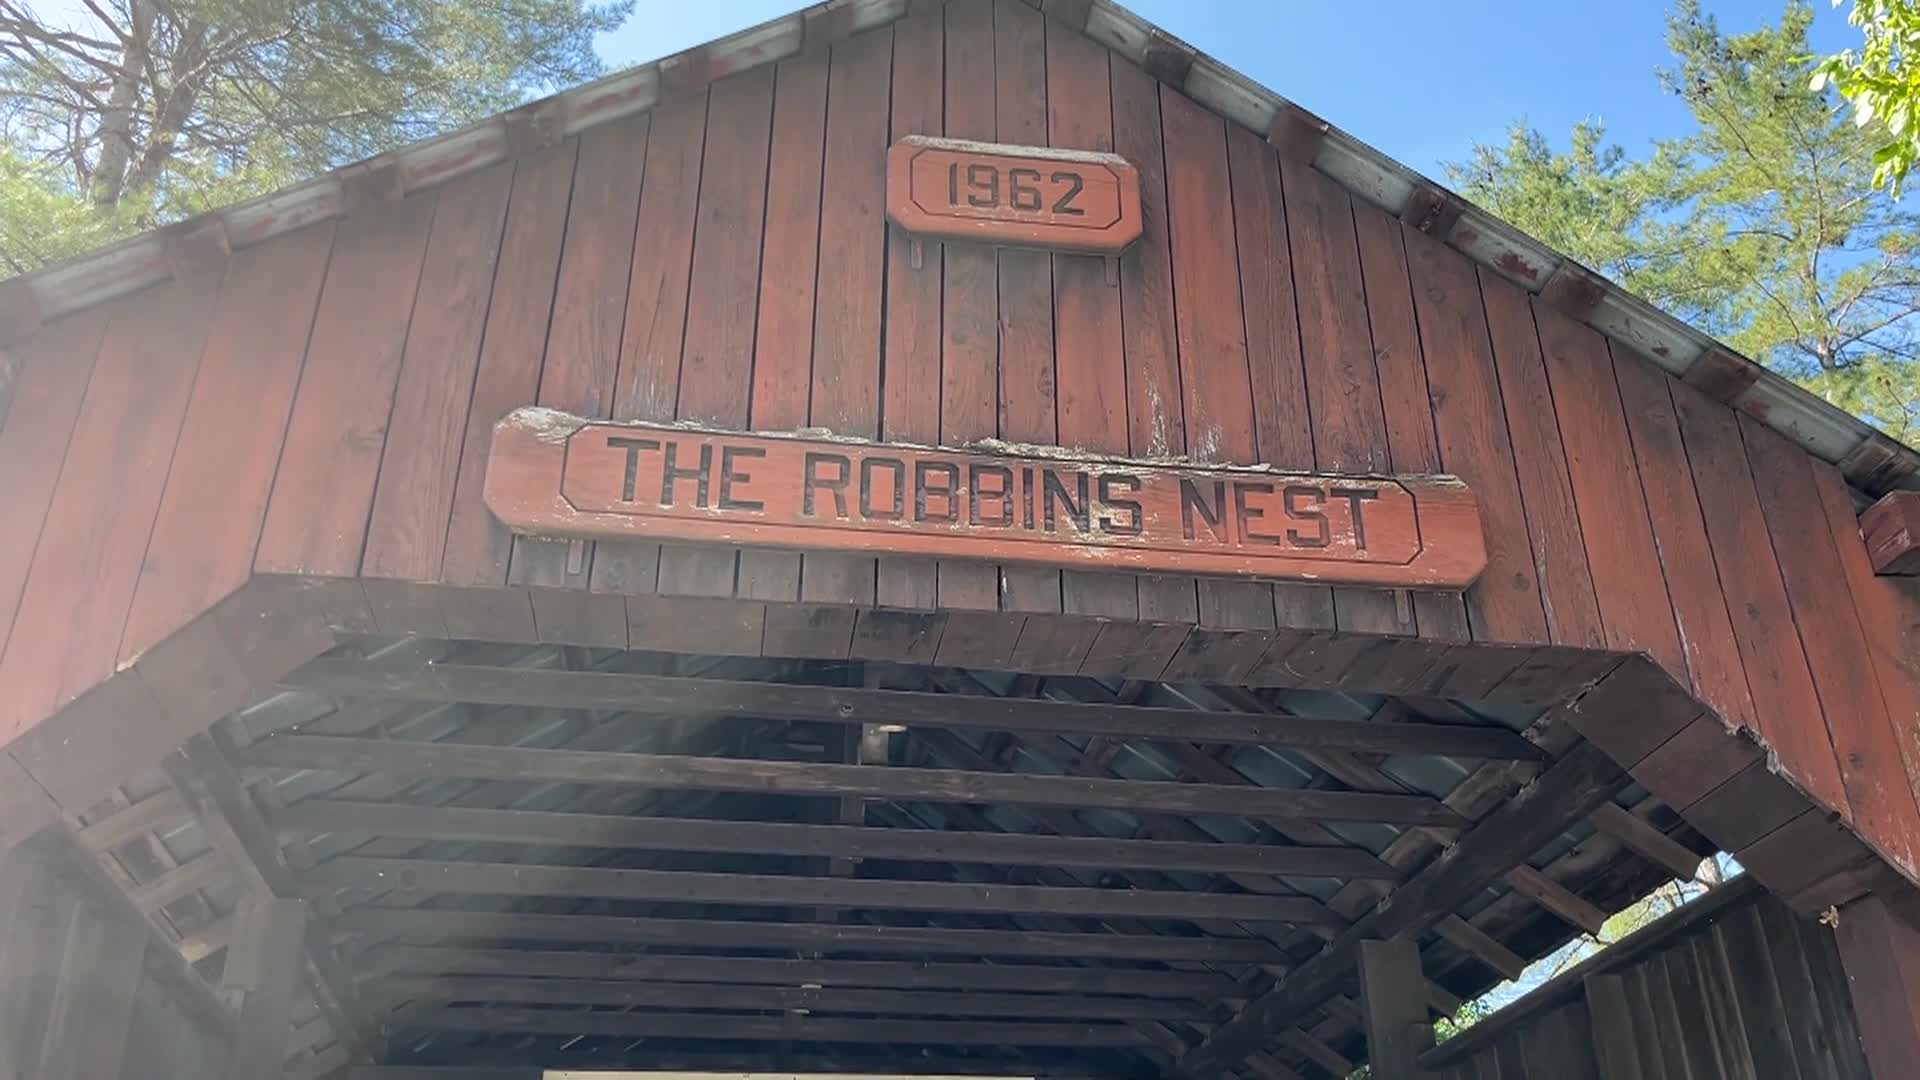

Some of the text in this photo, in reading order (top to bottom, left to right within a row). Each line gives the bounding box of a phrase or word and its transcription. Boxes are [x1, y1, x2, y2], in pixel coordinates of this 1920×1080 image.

[949, 162, 1085, 216] 1962
[607, 437, 1379, 551] THE ROBBINS NEST
